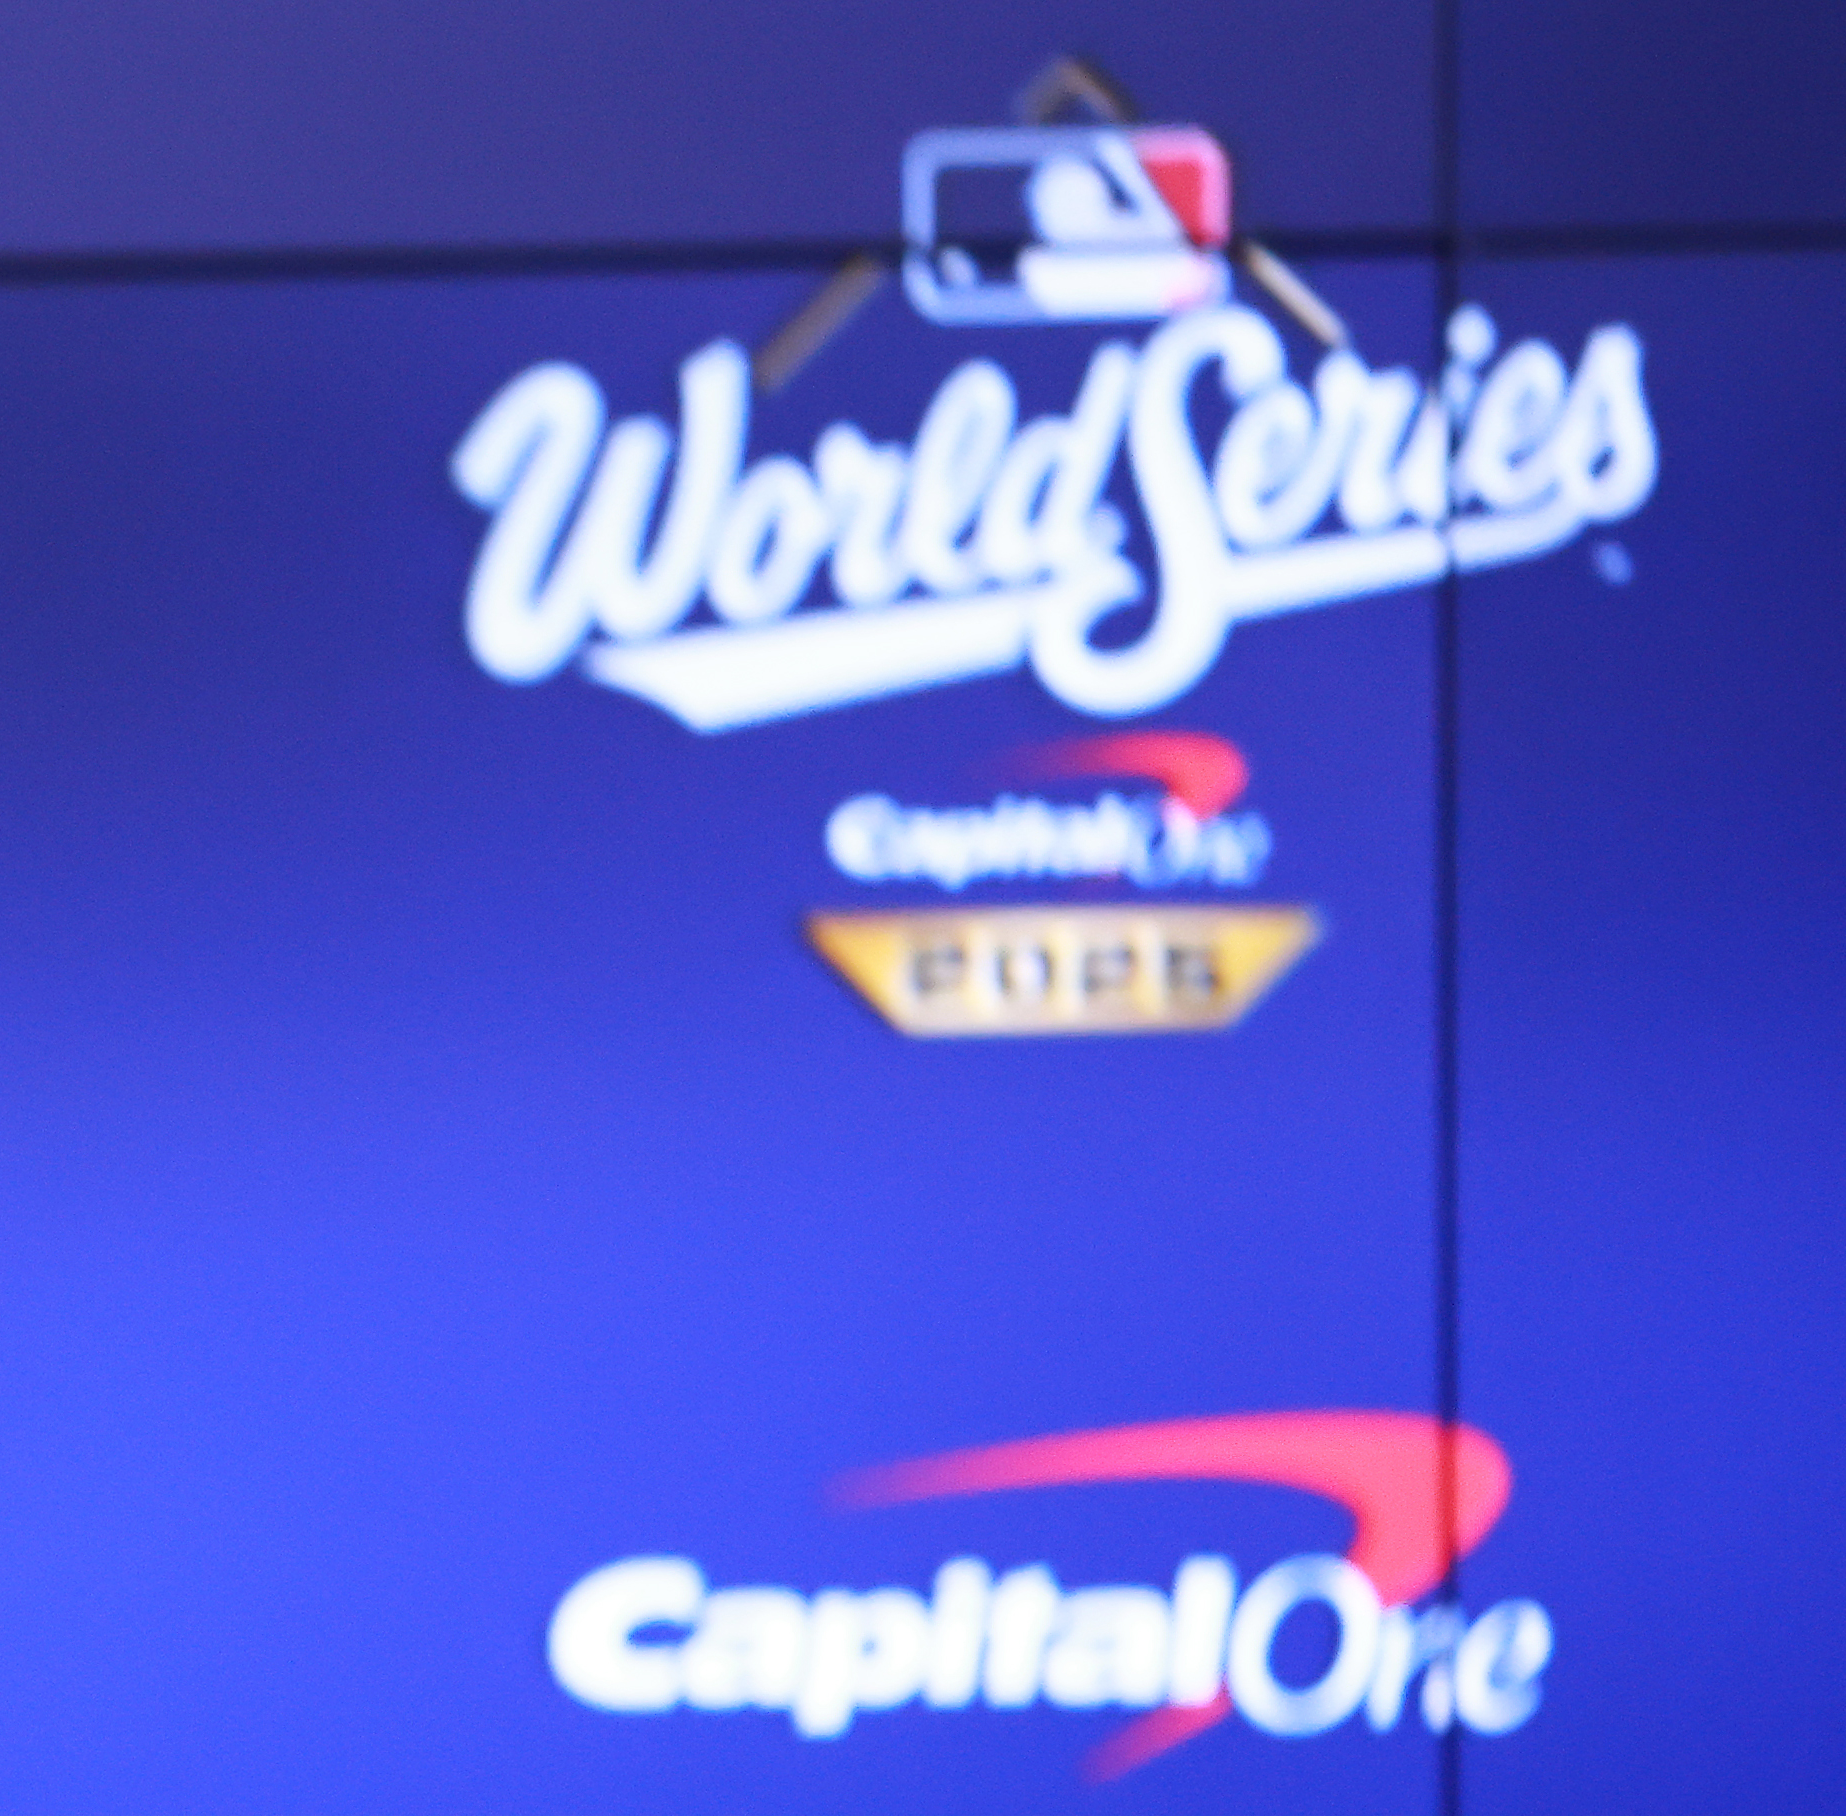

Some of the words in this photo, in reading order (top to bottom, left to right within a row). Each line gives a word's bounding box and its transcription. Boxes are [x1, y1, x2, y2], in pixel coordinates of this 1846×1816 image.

[450, 337, 1136, 685] World
[1026, 302, 1658, 717] Series
[546, 1554, 1237, 1740] Capital
[1227, 1552, 1554, 1738] One
